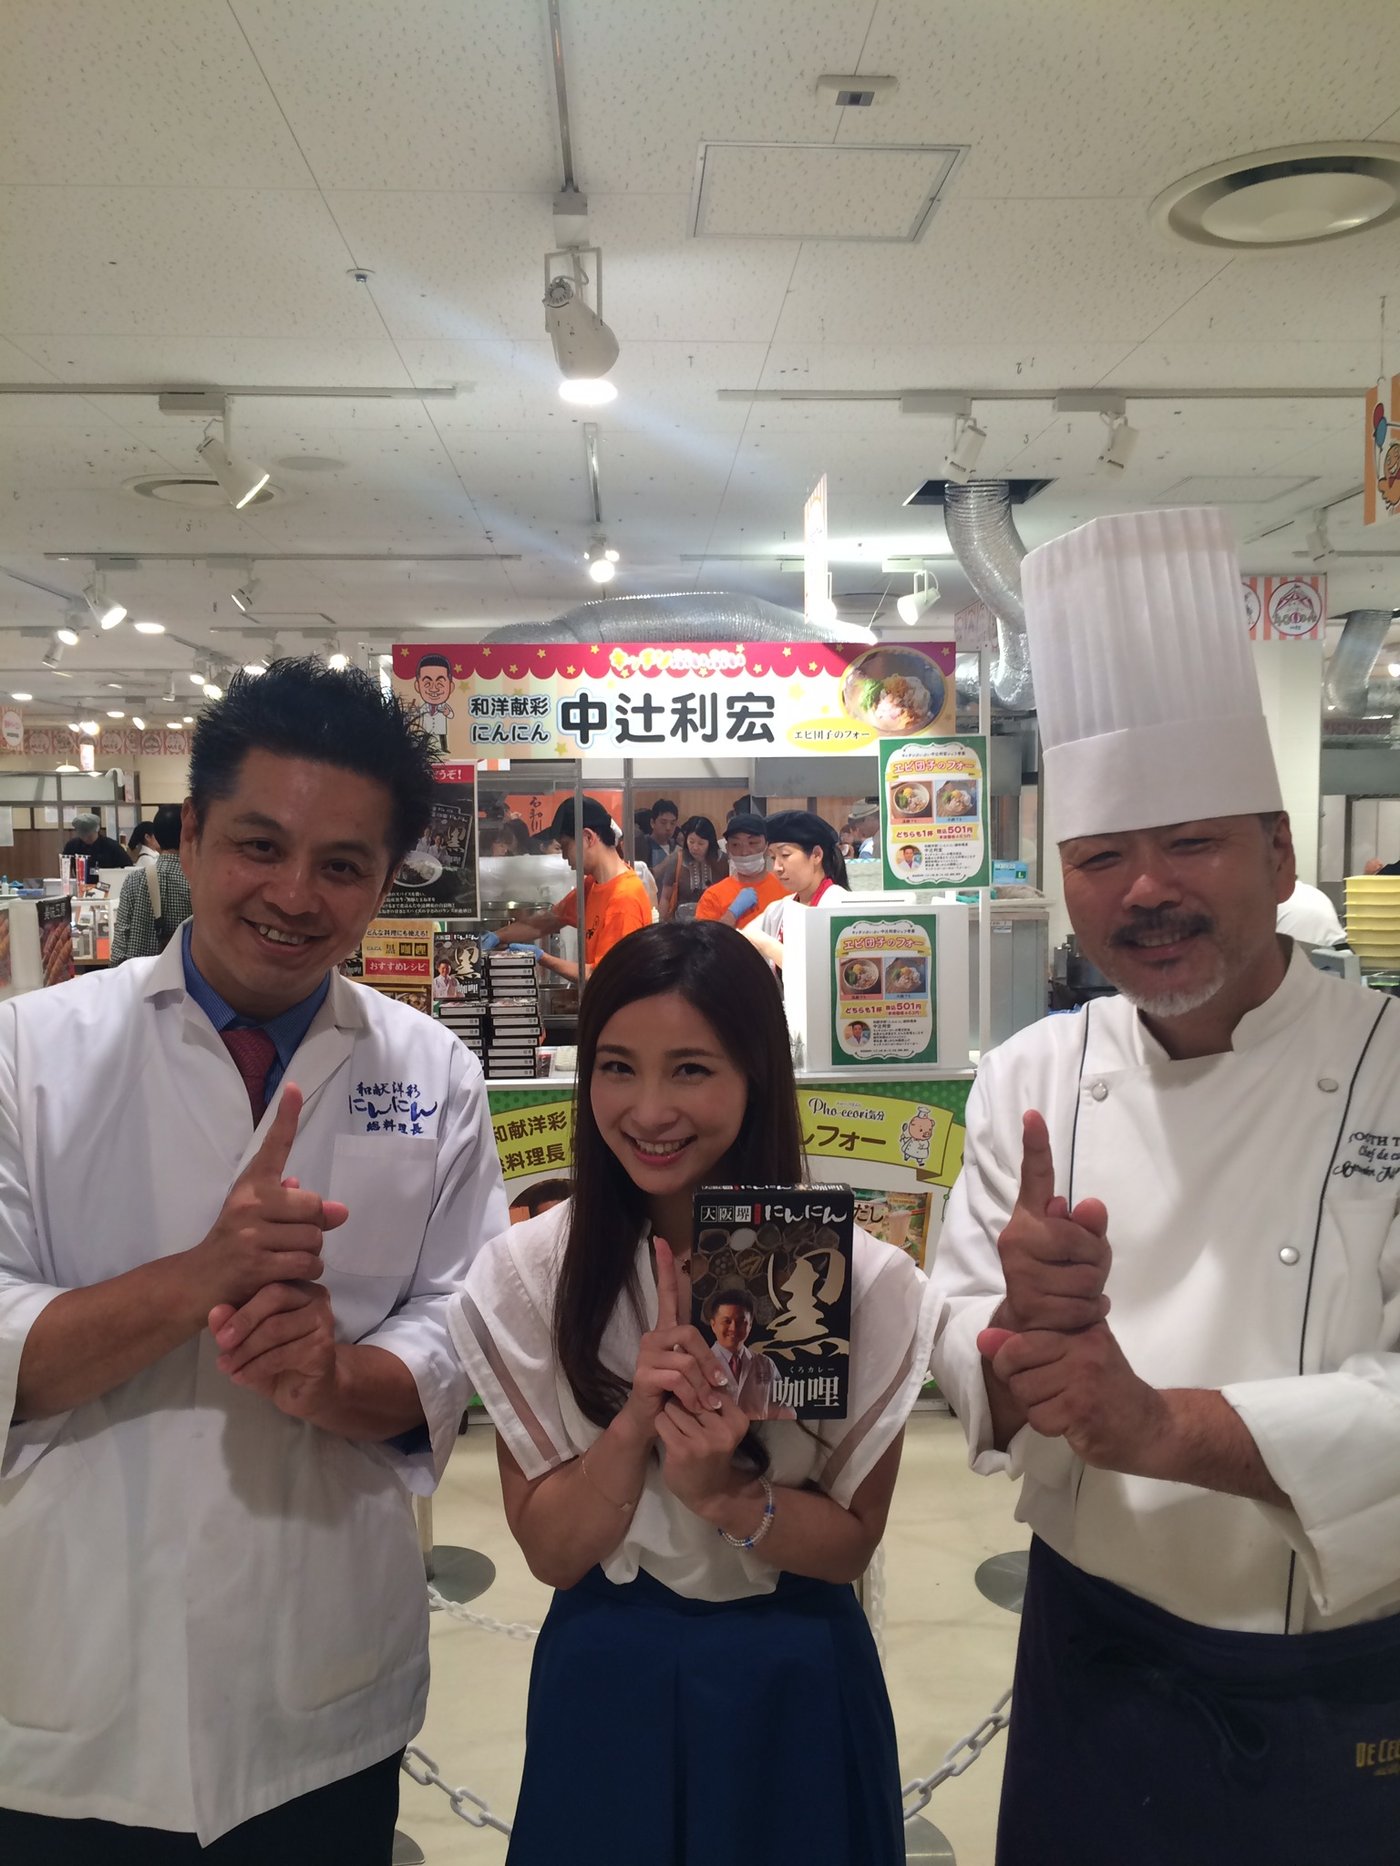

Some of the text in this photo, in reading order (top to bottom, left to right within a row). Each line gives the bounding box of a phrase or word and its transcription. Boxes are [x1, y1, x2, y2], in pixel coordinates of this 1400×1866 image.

[470, 697, 550, 716] 和洋献彩
[560, 692, 775, 745] 中辻利宏
[471, 723, 550, 742] にんにん
[794, 729, 871, 741] エビ団子のフォー
[894, 759, 975, 774] エビ団子のフォー
[843, 937, 924, 950] エビ団子のフォー
[370, 961, 427, 972] おすすめレシピ
[348, 1095, 438, 1122] にんにん
[765, 1204, 848, 1225] にんにん
[788, 1366, 835, 1374] くろカレー
